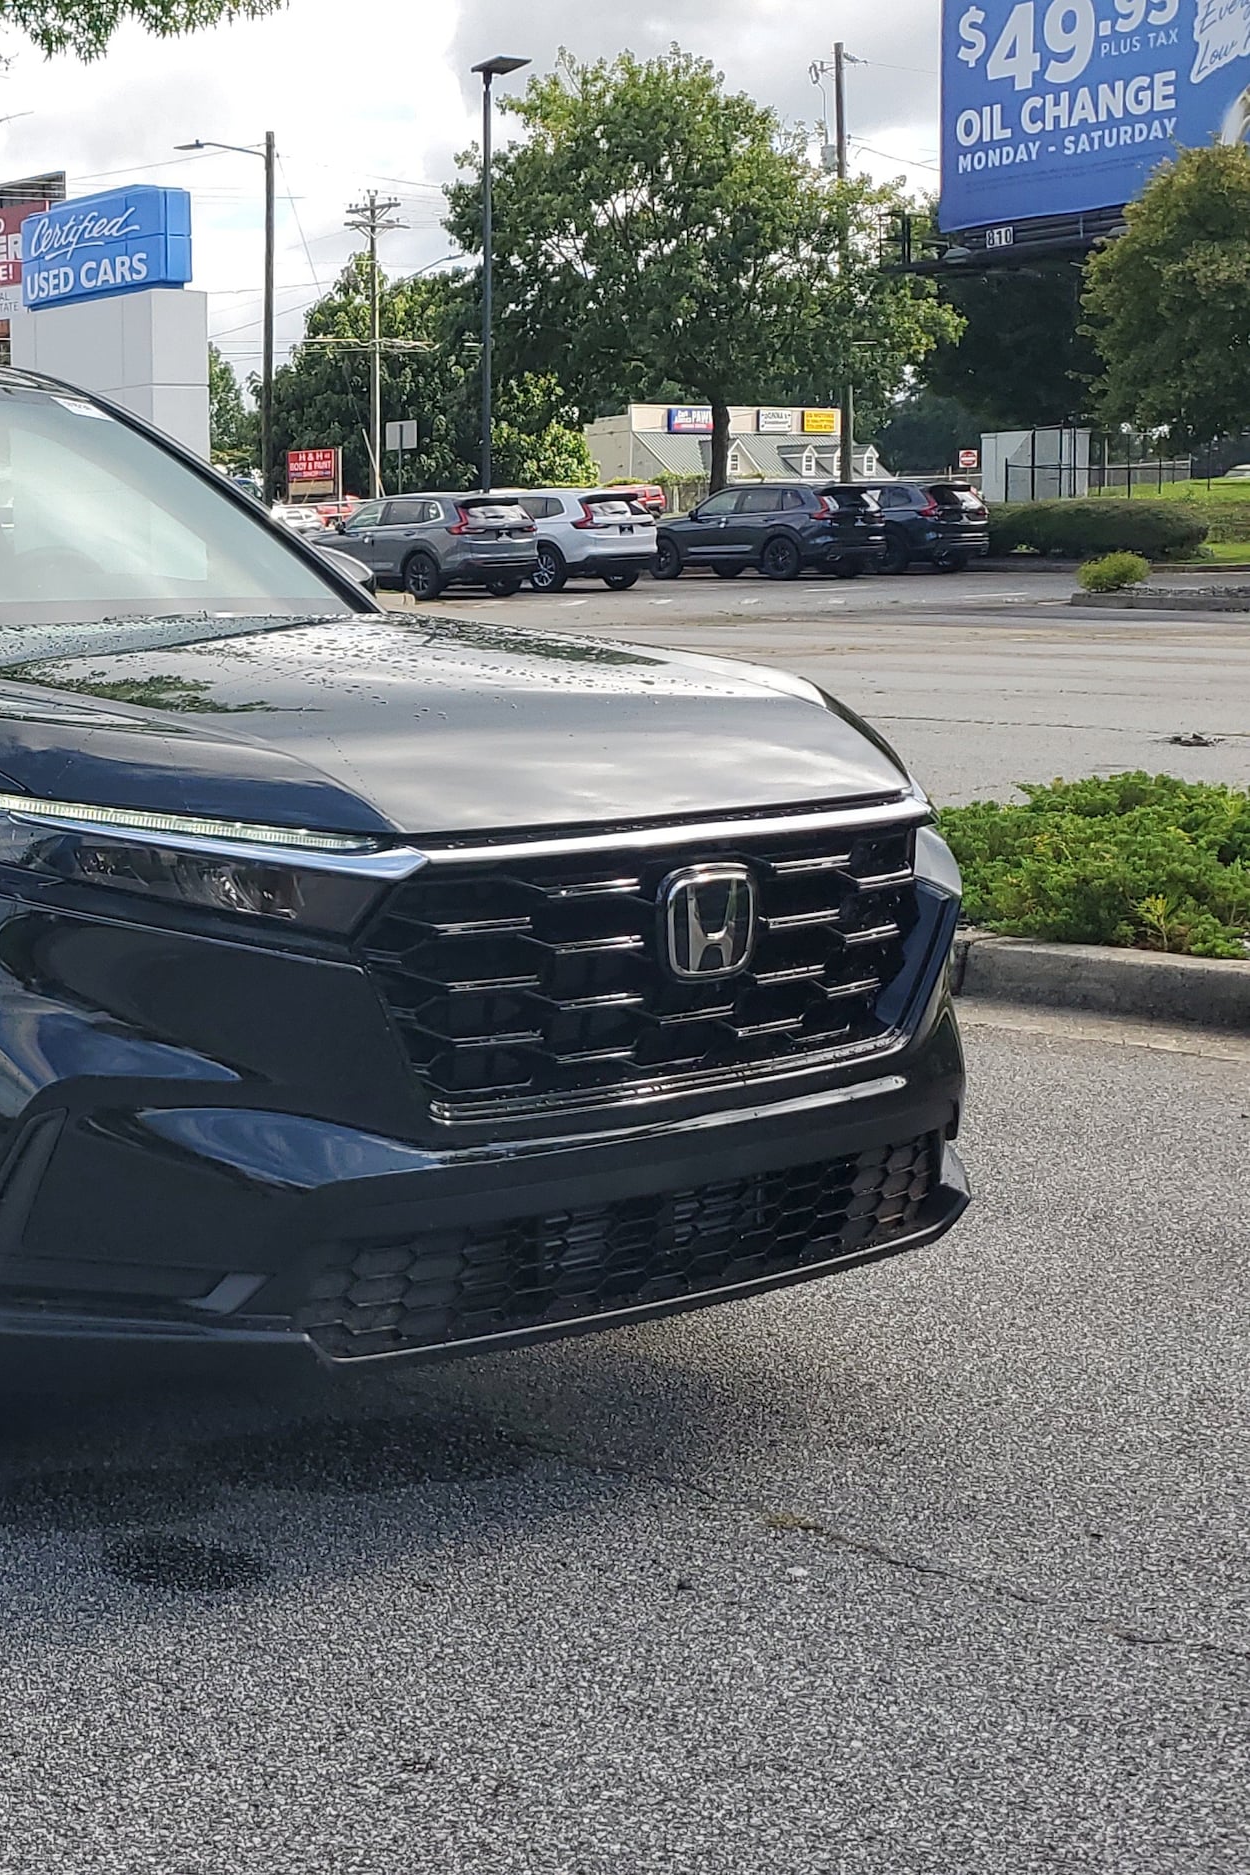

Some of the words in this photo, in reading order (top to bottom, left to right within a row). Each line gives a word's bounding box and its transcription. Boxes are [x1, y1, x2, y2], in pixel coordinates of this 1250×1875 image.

[1101, 34, 1141, 58] PLUS
[1147, 27, 1179, 45] TAX
[956, 105, 1012, 147] OIL
[1021, 70, 1176, 134] CHANGE
[958, 141, 1041, 174] MONDAY
[1064, 117, 1178, 155] SATURDAY
[31, 207, 140, 260] Certified
[988, 228, 1012, 246] 810
[26, 266, 74, 300] USED
[80, 252, 148, 288] CARS
[298, 453, 306, 461] H
[316, 451, 324, 461] H
